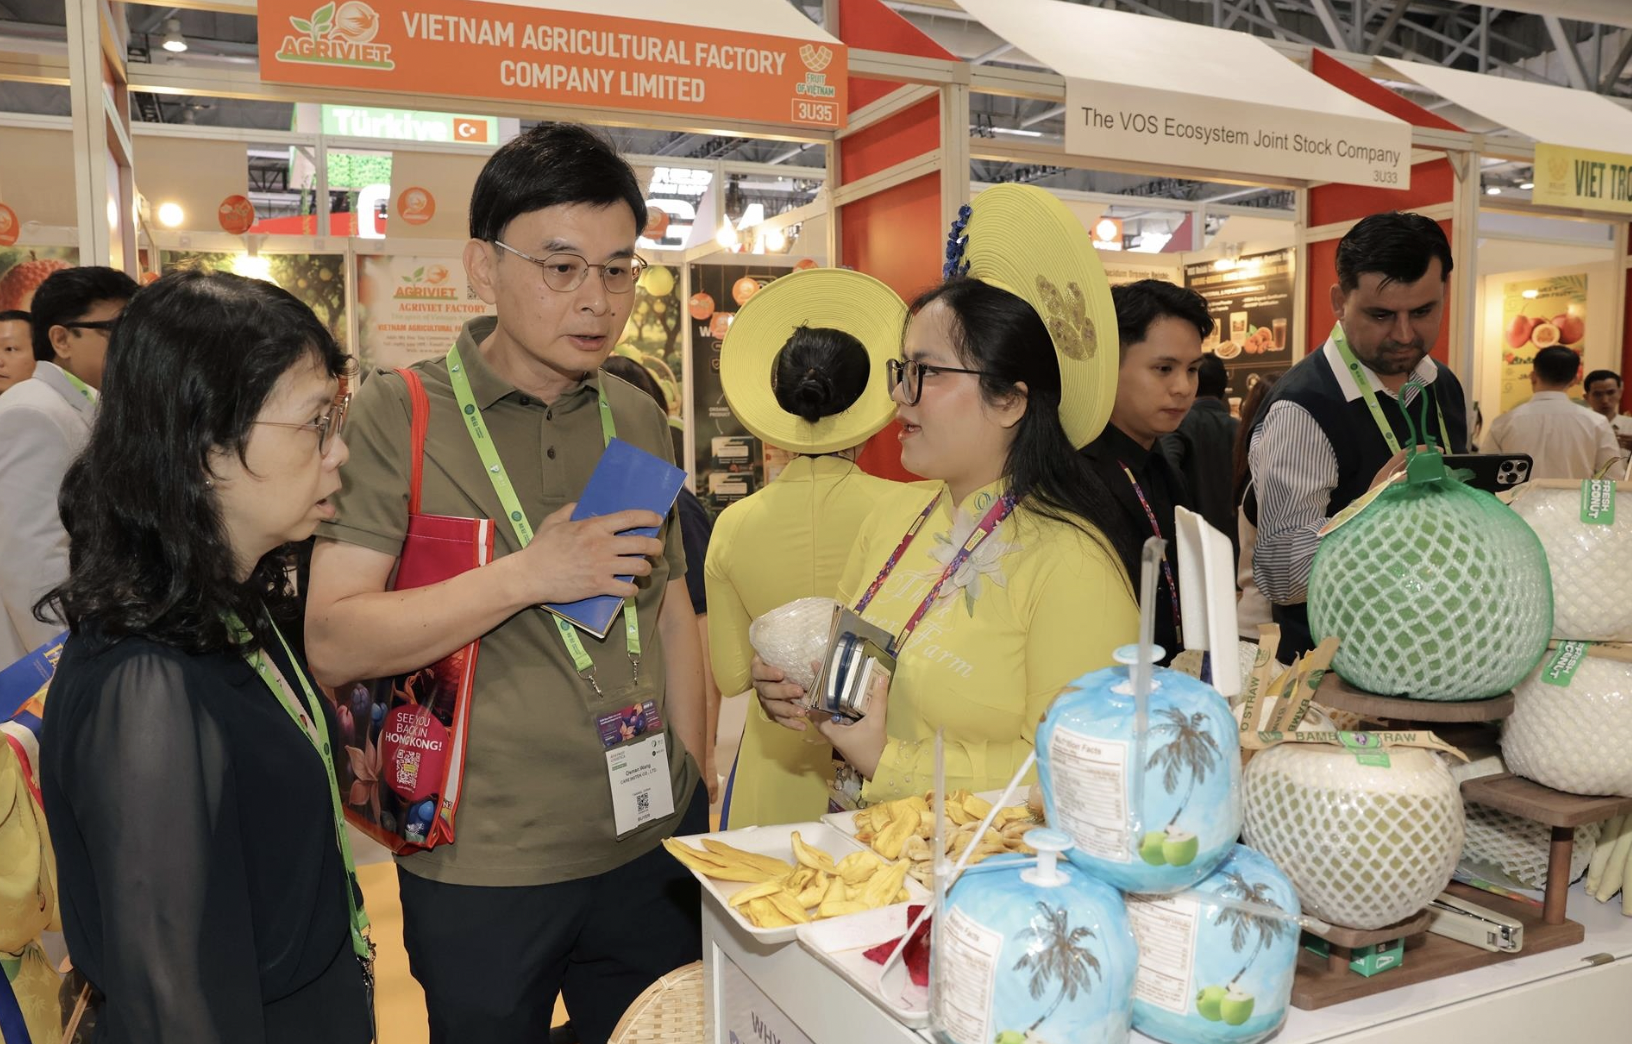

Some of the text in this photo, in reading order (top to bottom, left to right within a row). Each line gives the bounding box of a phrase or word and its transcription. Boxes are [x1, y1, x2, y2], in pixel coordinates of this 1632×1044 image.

[280, 37, 391, 64] AGRIVIET
[402, 11, 786, 75] VIETNAM AGRICULTURAL FACTORY
[500, 60, 705, 103] COMPANY LIMITED
[797, 83, 807, 94] OF
[806, 72, 826, 85] FRUIT
[332, 108, 447, 141] Türkiye
[799, 102, 833, 122] 3U35
[1081, 107, 1401, 168] The VOS Ecosystem Joint Stock Company
[1373, 170, 1398, 184] 3U33
[1575, 159, 1606, 199] VIET
[395, 286, 457, 298] AGRIVIET
[398, 303, 487, 313] AGRIVIET FACTORY
[1600, 479, 1611, 512] FRESH
[1243, 676, 1260, 719] STRAW
[396, 712, 431, 727] SEE YOU
